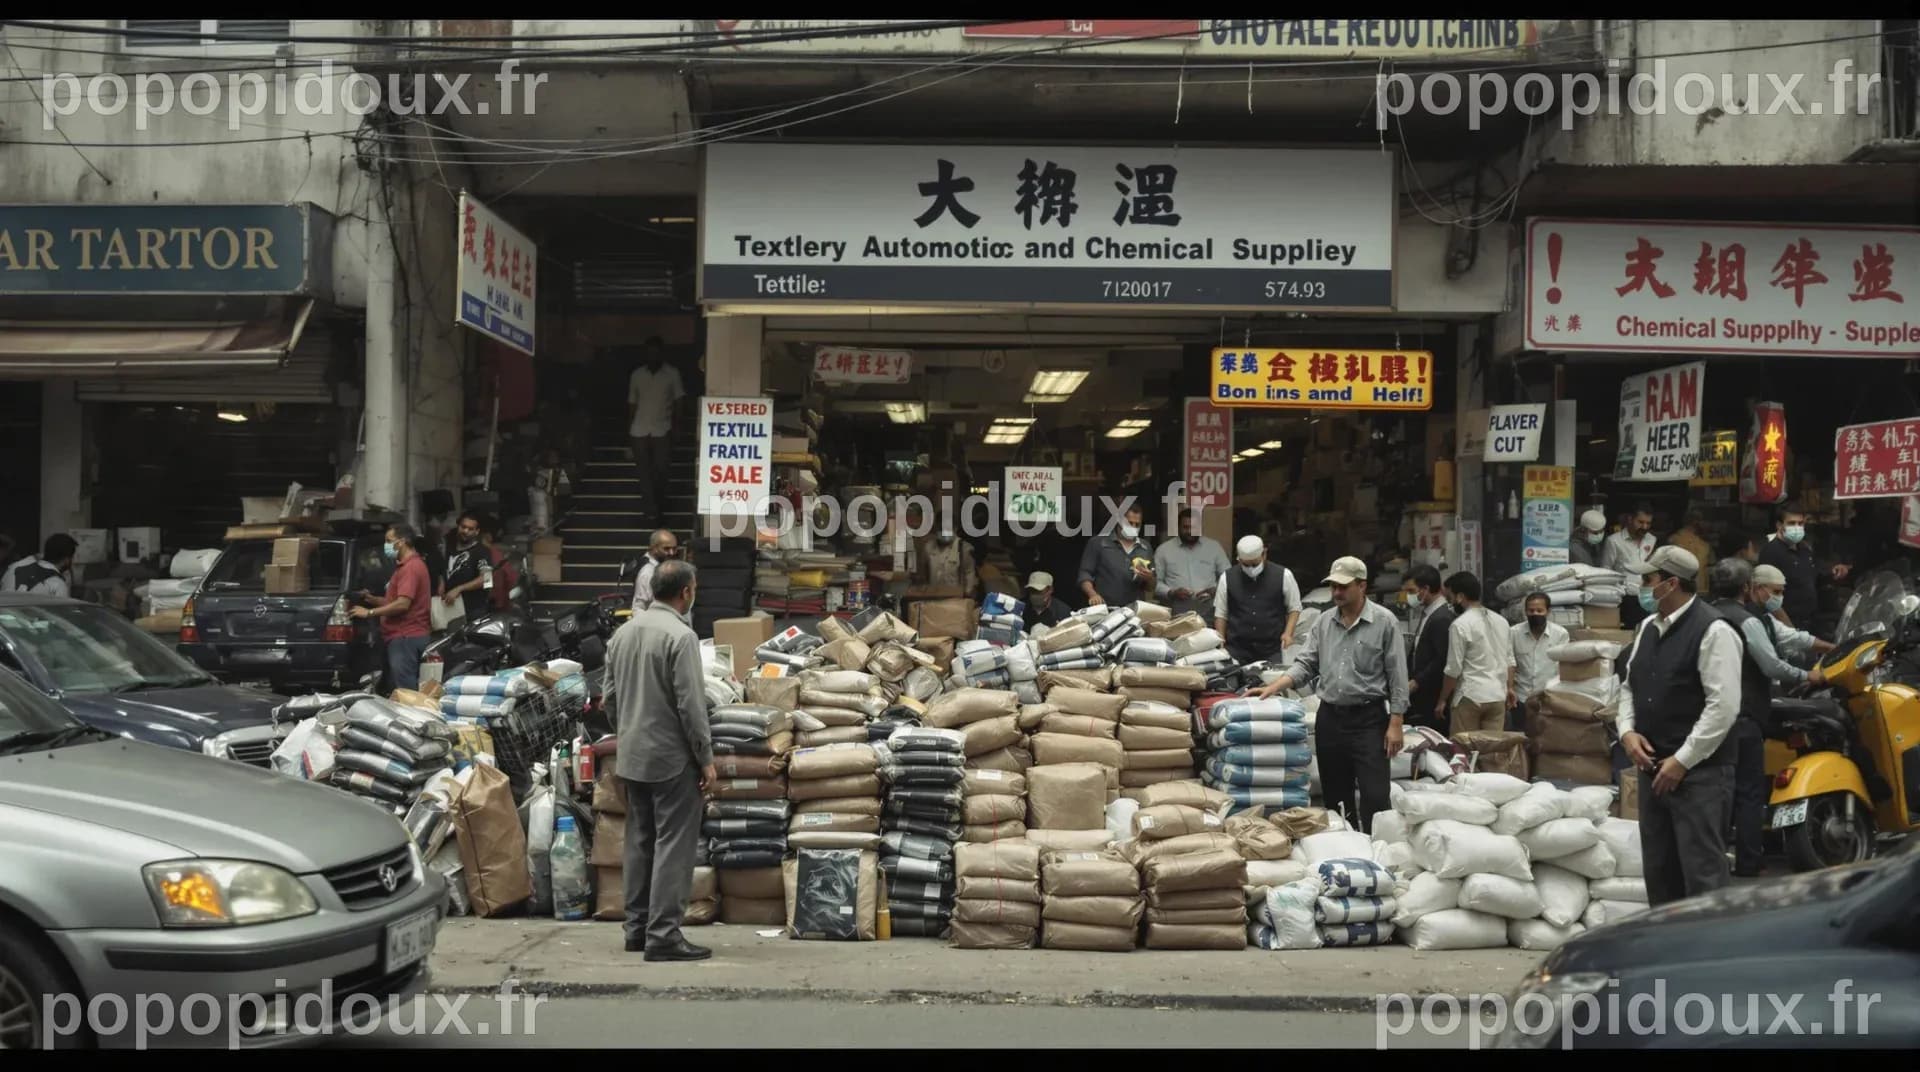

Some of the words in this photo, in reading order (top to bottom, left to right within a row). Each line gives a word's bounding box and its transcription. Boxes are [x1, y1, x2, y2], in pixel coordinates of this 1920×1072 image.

[70, 227, 279, 270] TARTOR
[734, 235, 847, 262] Textlery
[1024, 237, 1074, 259] and
[1085, 237, 1213, 260] Chemical
[1232, 238, 1357, 266] Suppliey
[754, 274, 826, 294] Tettile:
[1265, 281, 1326, 298] 574.93
[1616, 315, 1716, 338] Chemical
[1218, 384, 1257, 399] Bon
[1308, 386, 1352, 401] amd
[708, 422, 768, 438] TEXTILL
[1646, 421, 1691, 453] HEER
[708, 444, 763, 460] FRATIL
[1494, 436, 1526, 453] CUT
[709, 464, 763, 484] SALE
[1190, 471, 1228, 495] 500
